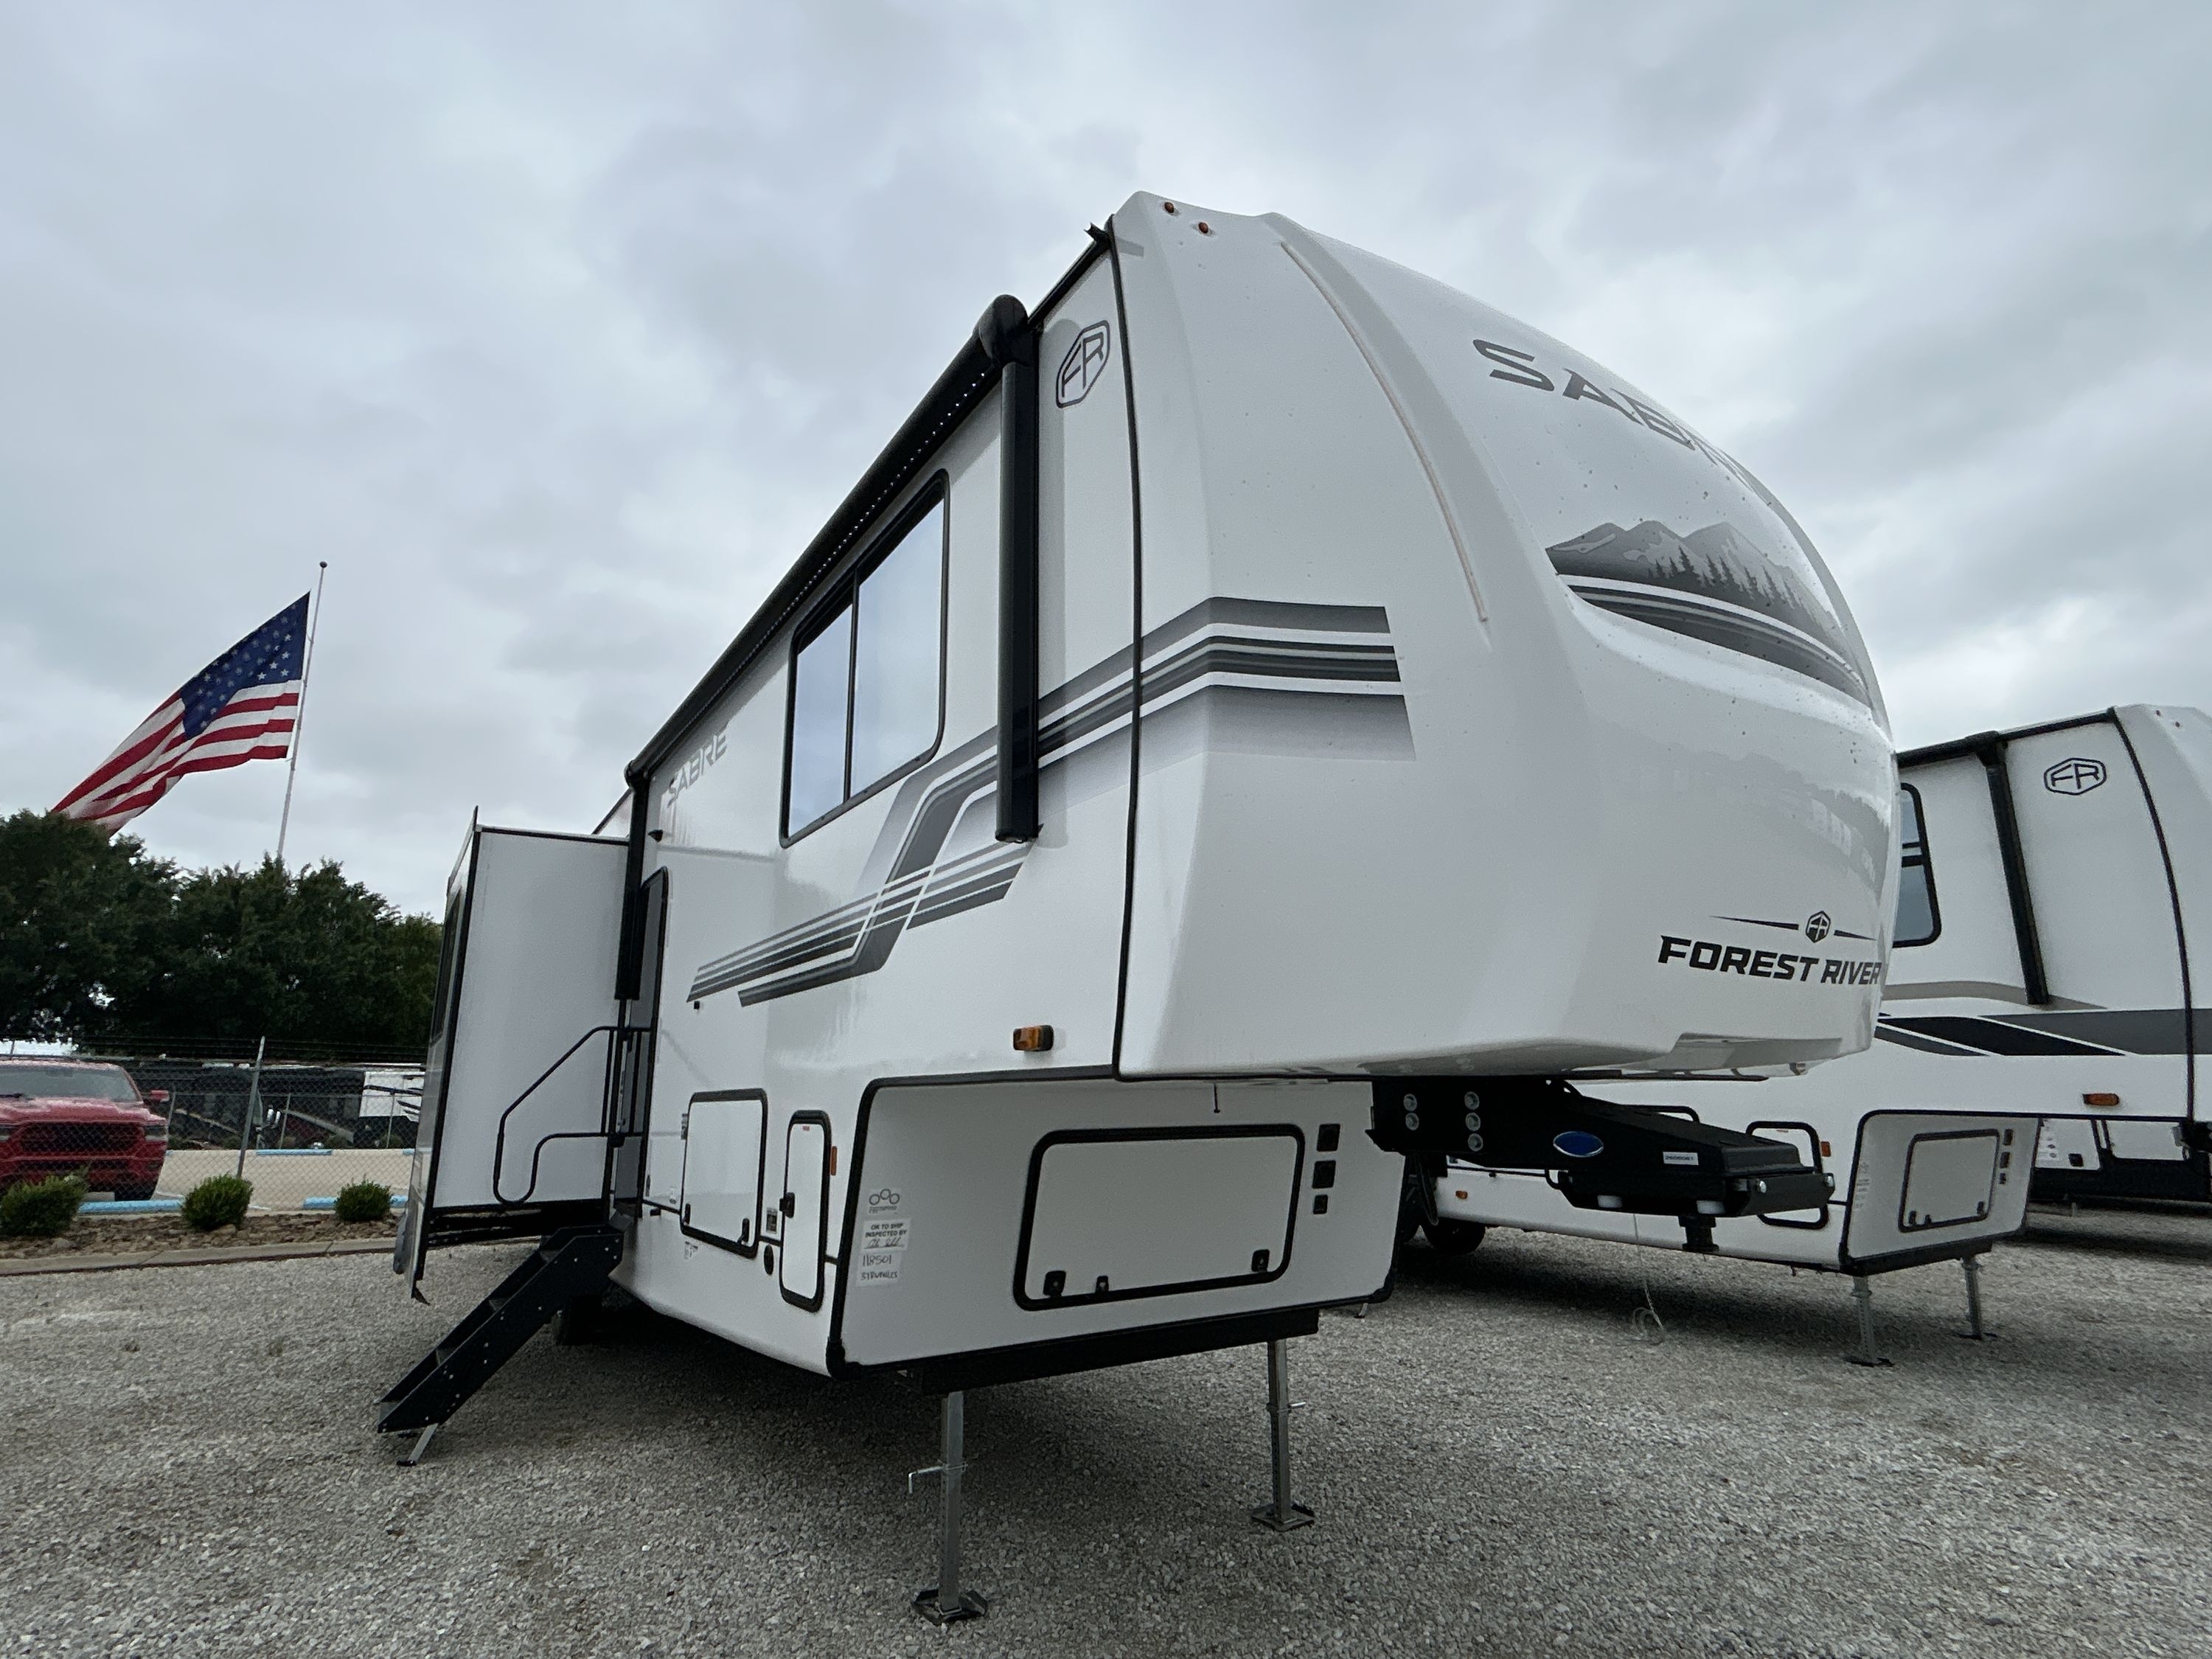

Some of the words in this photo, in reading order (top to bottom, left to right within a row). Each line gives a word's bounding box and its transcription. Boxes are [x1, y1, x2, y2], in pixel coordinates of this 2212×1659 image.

[1658, 935, 1819, 982] FOREST
[1820, 959, 1882, 985] RIVER
[865, 1230, 898, 1238] INSPECTED
